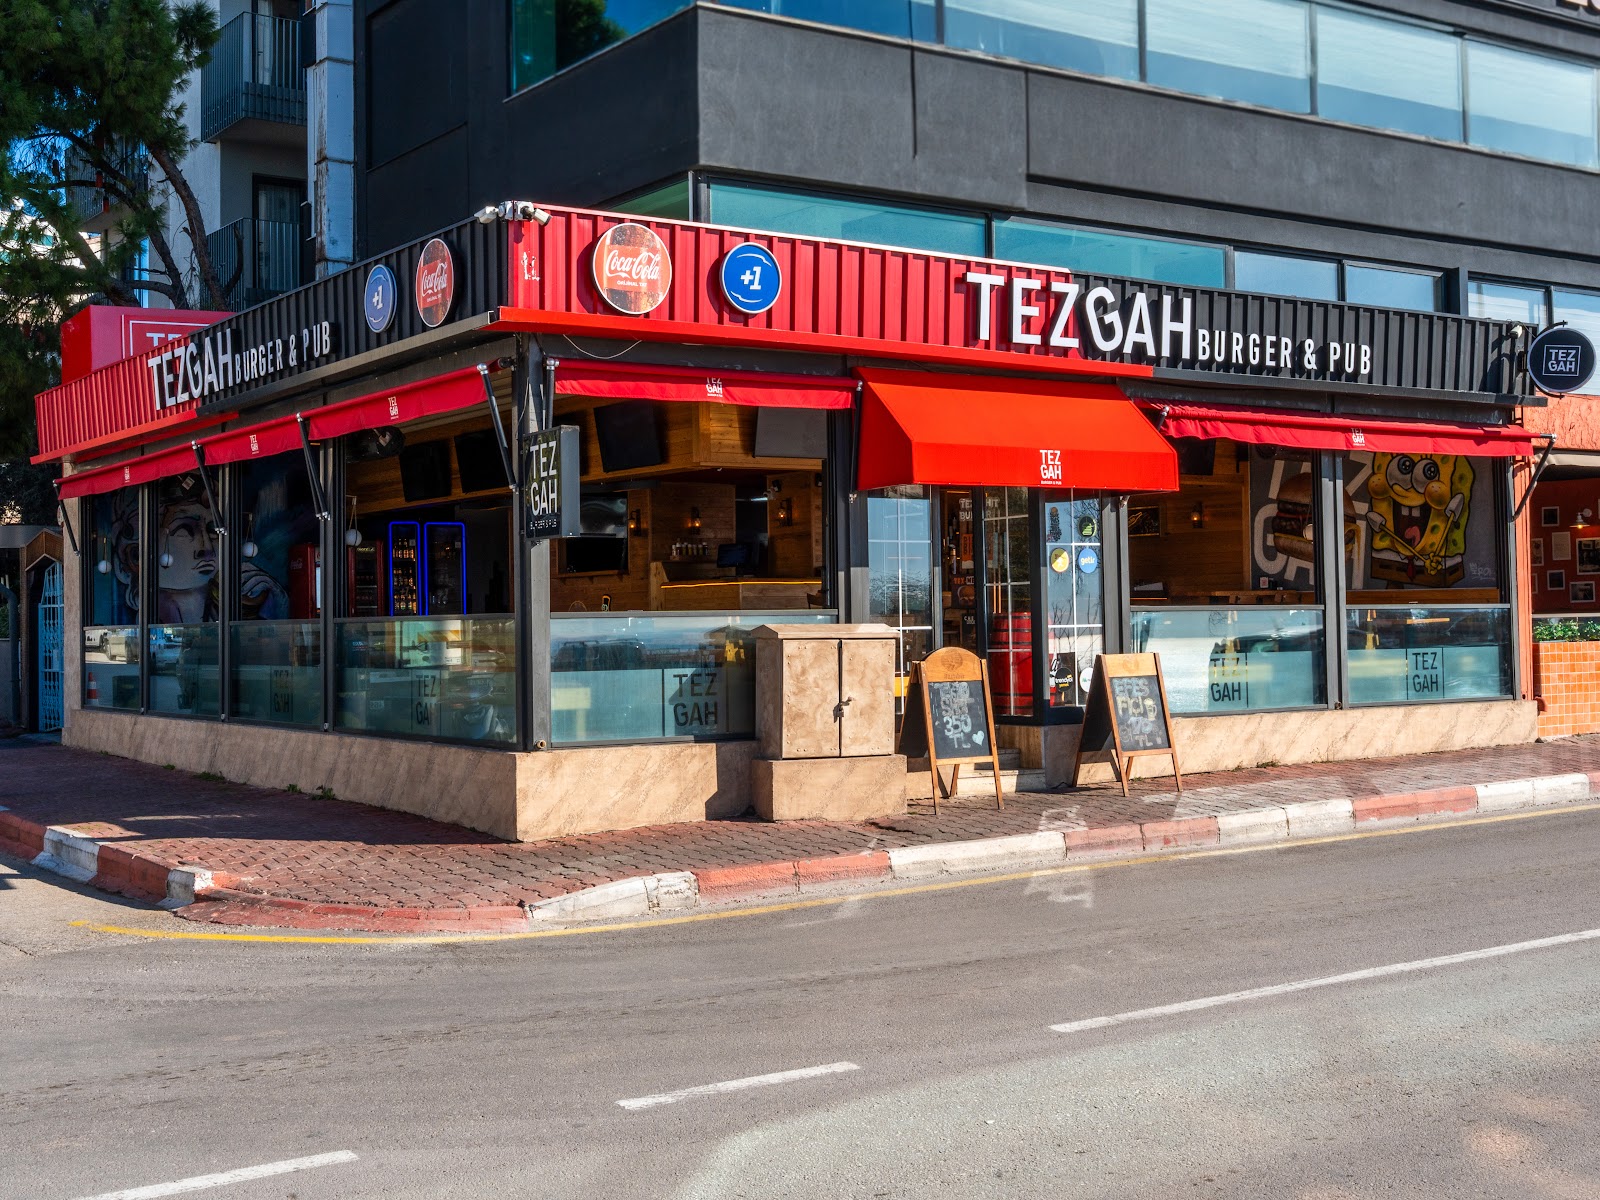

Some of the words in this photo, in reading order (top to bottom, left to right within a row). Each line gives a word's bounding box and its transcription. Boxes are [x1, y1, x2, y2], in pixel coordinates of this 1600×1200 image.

[606, 250, 660, 280] Coca-Cola
[965, 271, 1193, 360] TEZGAH
[1197, 327, 1292, 369] BURGER
[1303, 338, 1316, 371] &
[1328, 341, 1372, 375] PUB
[148, 327, 233, 411] TEZGAH
[235, 344, 284, 384] BURGER
[288, 333, 298, 367] &
[303, 320, 331, 362] PUB
[1548, 360, 1576, 372] GAH
[1549, 349, 1577, 361] TEZ
[530, 440, 557, 479] TEZ
[1039, 449, 1061, 465] TEZ
[1040, 464, 1062, 480] GAH
[530, 478, 558, 516] GAH
[1080, 557, 1096, 566] getir
[1210, 657, 1240, 679] TEZ
[1412, 651, 1438, 671] TEZ
[415, 674, 437, 698] TEZ
[672, 672, 718, 698] TEZ
[1111, 677, 1150, 698] EFES
[1210, 682, 1242, 702] GAH
[1412, 673, 1439, 693] GAH
[673, 701, 718, 727] GAH
[943, 713, 972, 737] 350
